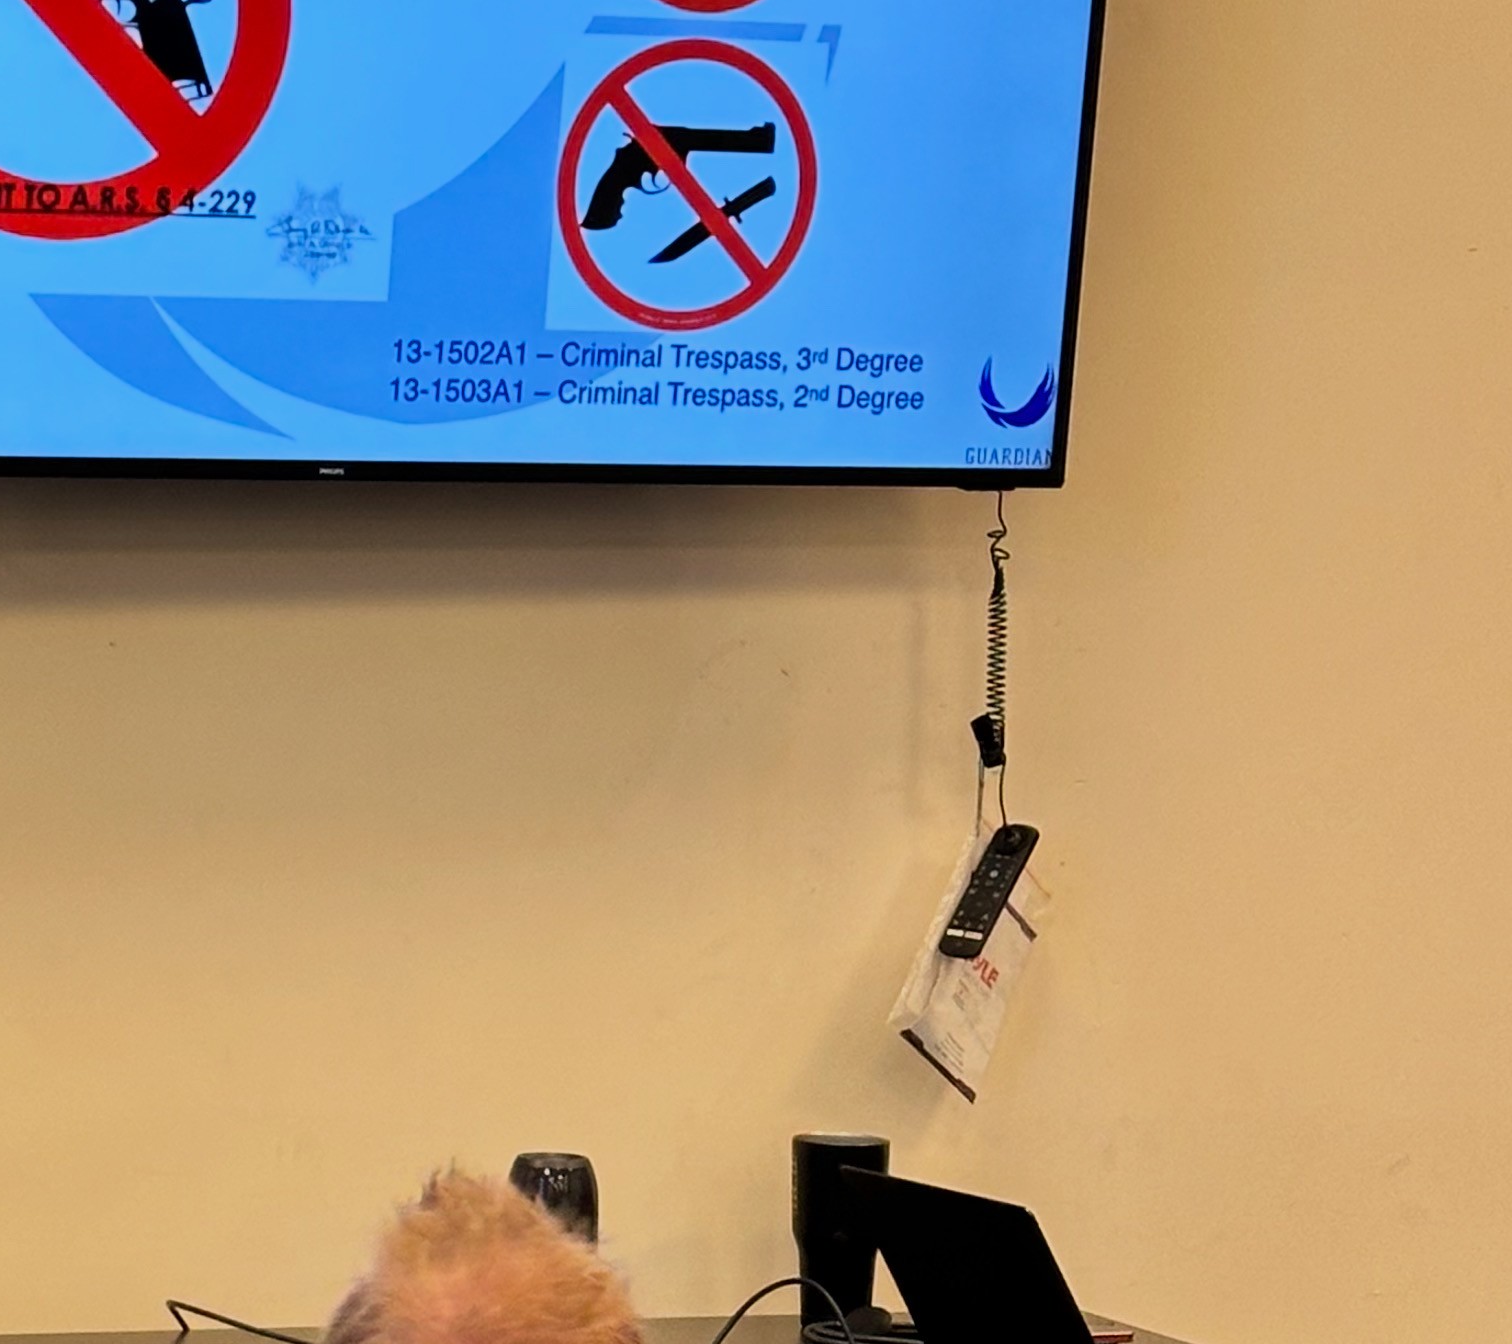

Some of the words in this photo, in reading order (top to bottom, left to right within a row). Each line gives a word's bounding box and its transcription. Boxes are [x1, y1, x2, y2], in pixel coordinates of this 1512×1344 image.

[23, 182, 62, 211] TO
[68, 184, 147, 213] A.R.S.
[180, 189, 257, 215] 4-229
[393, 338, 527, 366] 13-1502A1
[560, 341, 662, 369] Criminal
[670, 344, 788, 375] Trespass,
[796, 347, 829, 371] 3rd
[836, 347, 924, 378] Degree
[389, 377, 524, 404] 13-1503A1
[557, 379, 659, 405] Criminal
[667, 381, 785, 413] Trespass,
[793, 384, 830, 408] 2nd
[837, 384, 925, 415] Degree
